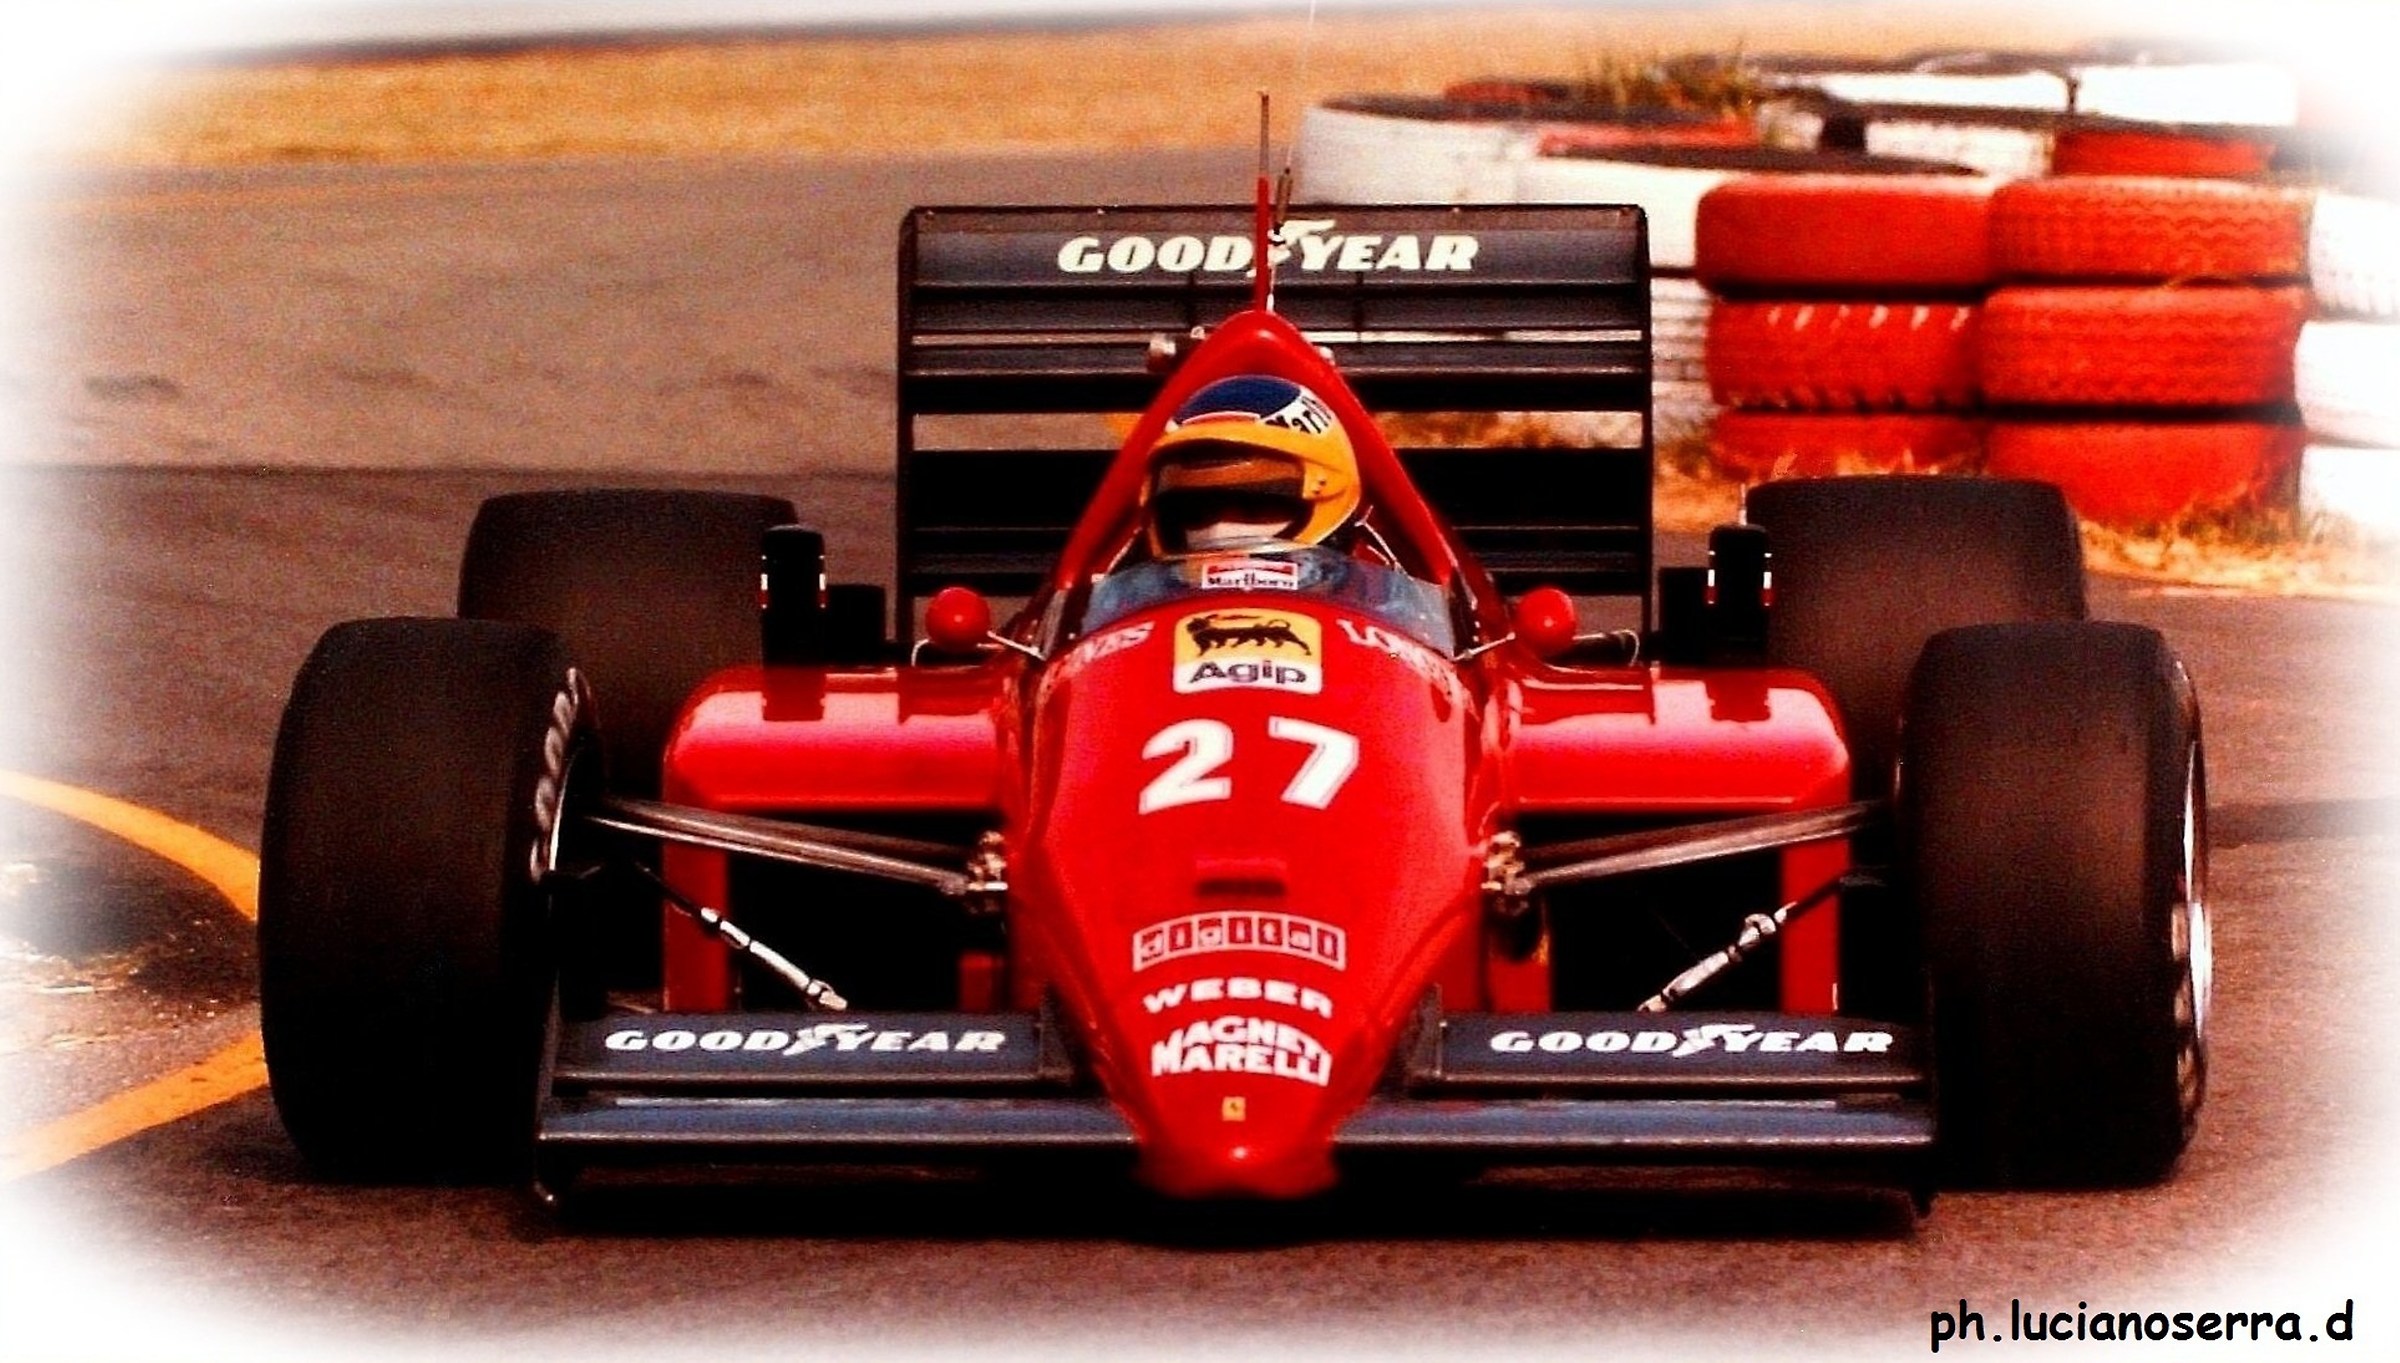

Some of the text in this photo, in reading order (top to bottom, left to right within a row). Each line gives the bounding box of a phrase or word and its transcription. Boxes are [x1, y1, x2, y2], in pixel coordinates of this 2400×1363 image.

[1057, 228, 1480, 275] GOODYEAR
[1190, 660, 1307, 685] Agip
[1138, 715, 1360, 815] 27
[1138, 914, 1342, 965] digital
[1143, 977, 1333, 1019] WEBER
[605, 1025, 1006, 1054] GOODYEAR
[1490, 1026, 1894, 1056] GOODYEAR
